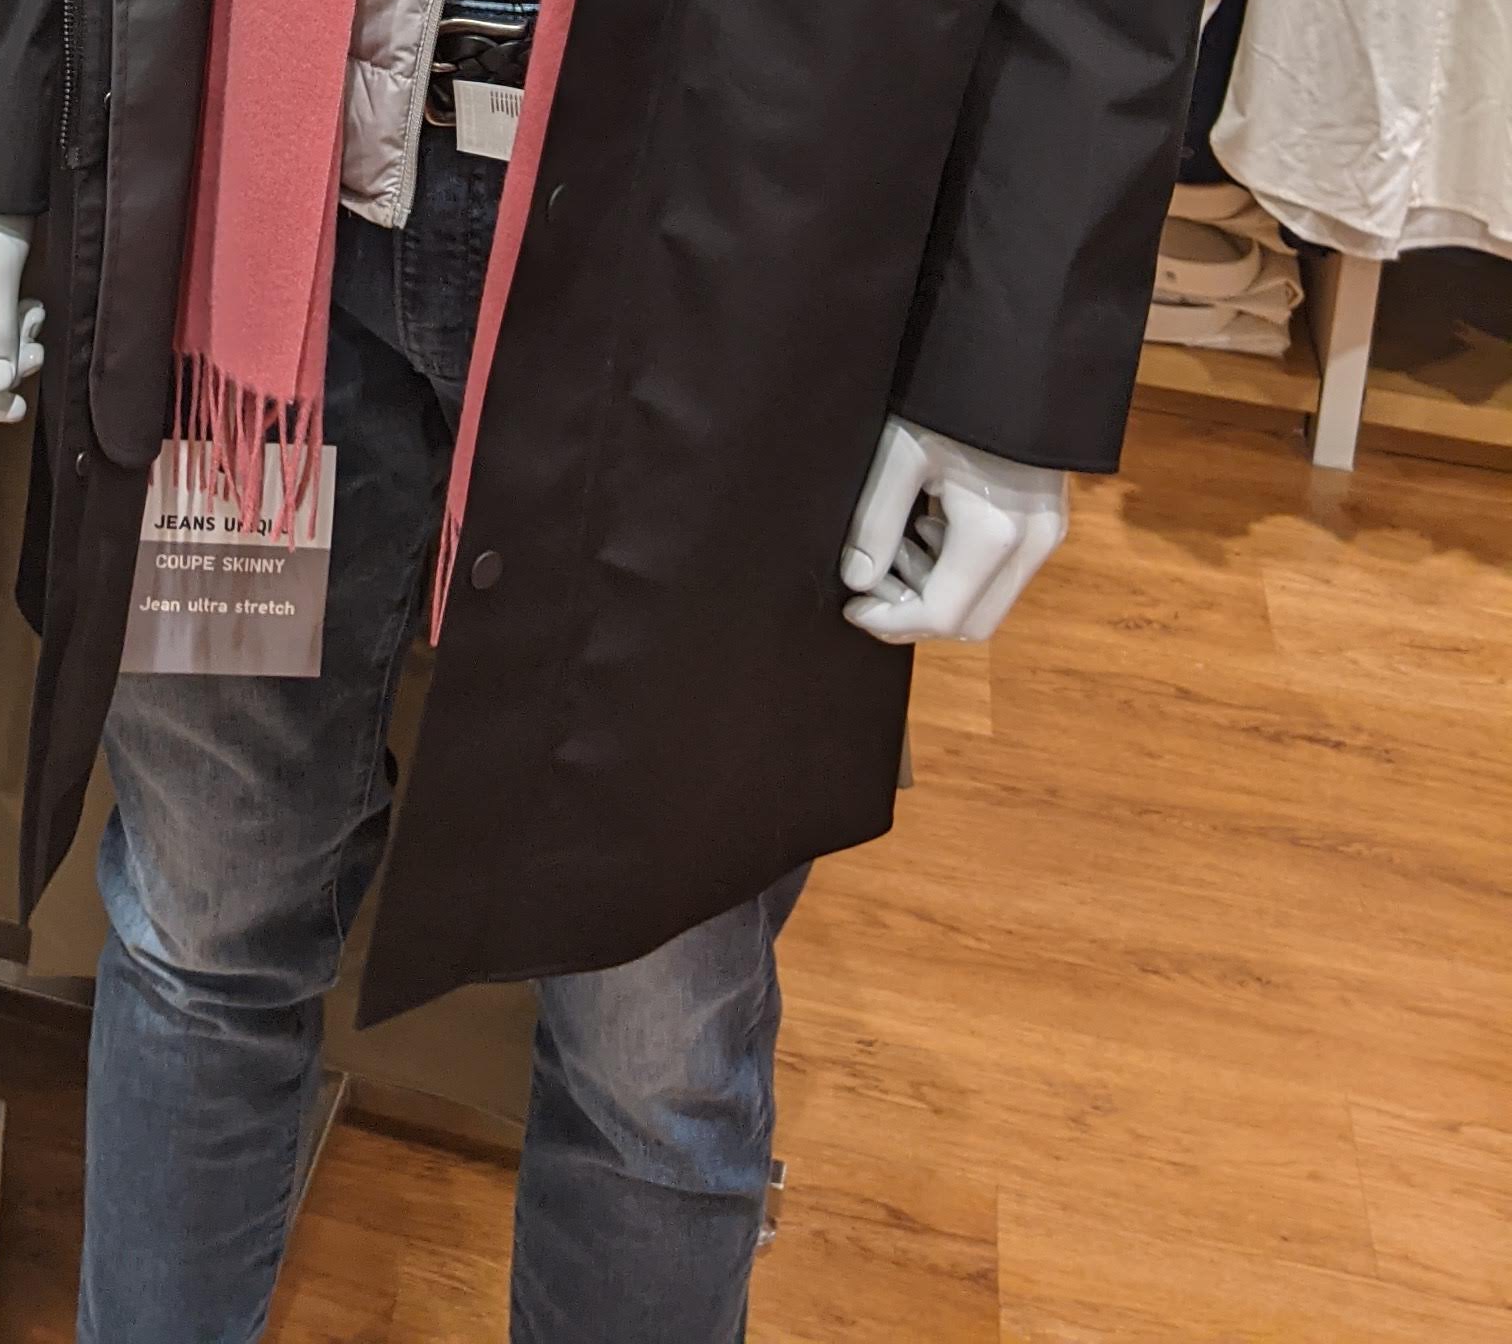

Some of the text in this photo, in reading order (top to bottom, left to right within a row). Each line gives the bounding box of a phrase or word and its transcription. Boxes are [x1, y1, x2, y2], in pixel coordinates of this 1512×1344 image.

[154, 514, 216, 532] JEANS
[155, 554, 286, 574] COUPE SKINNY
[139, 596, 295, 615] Jean ultra stretch
